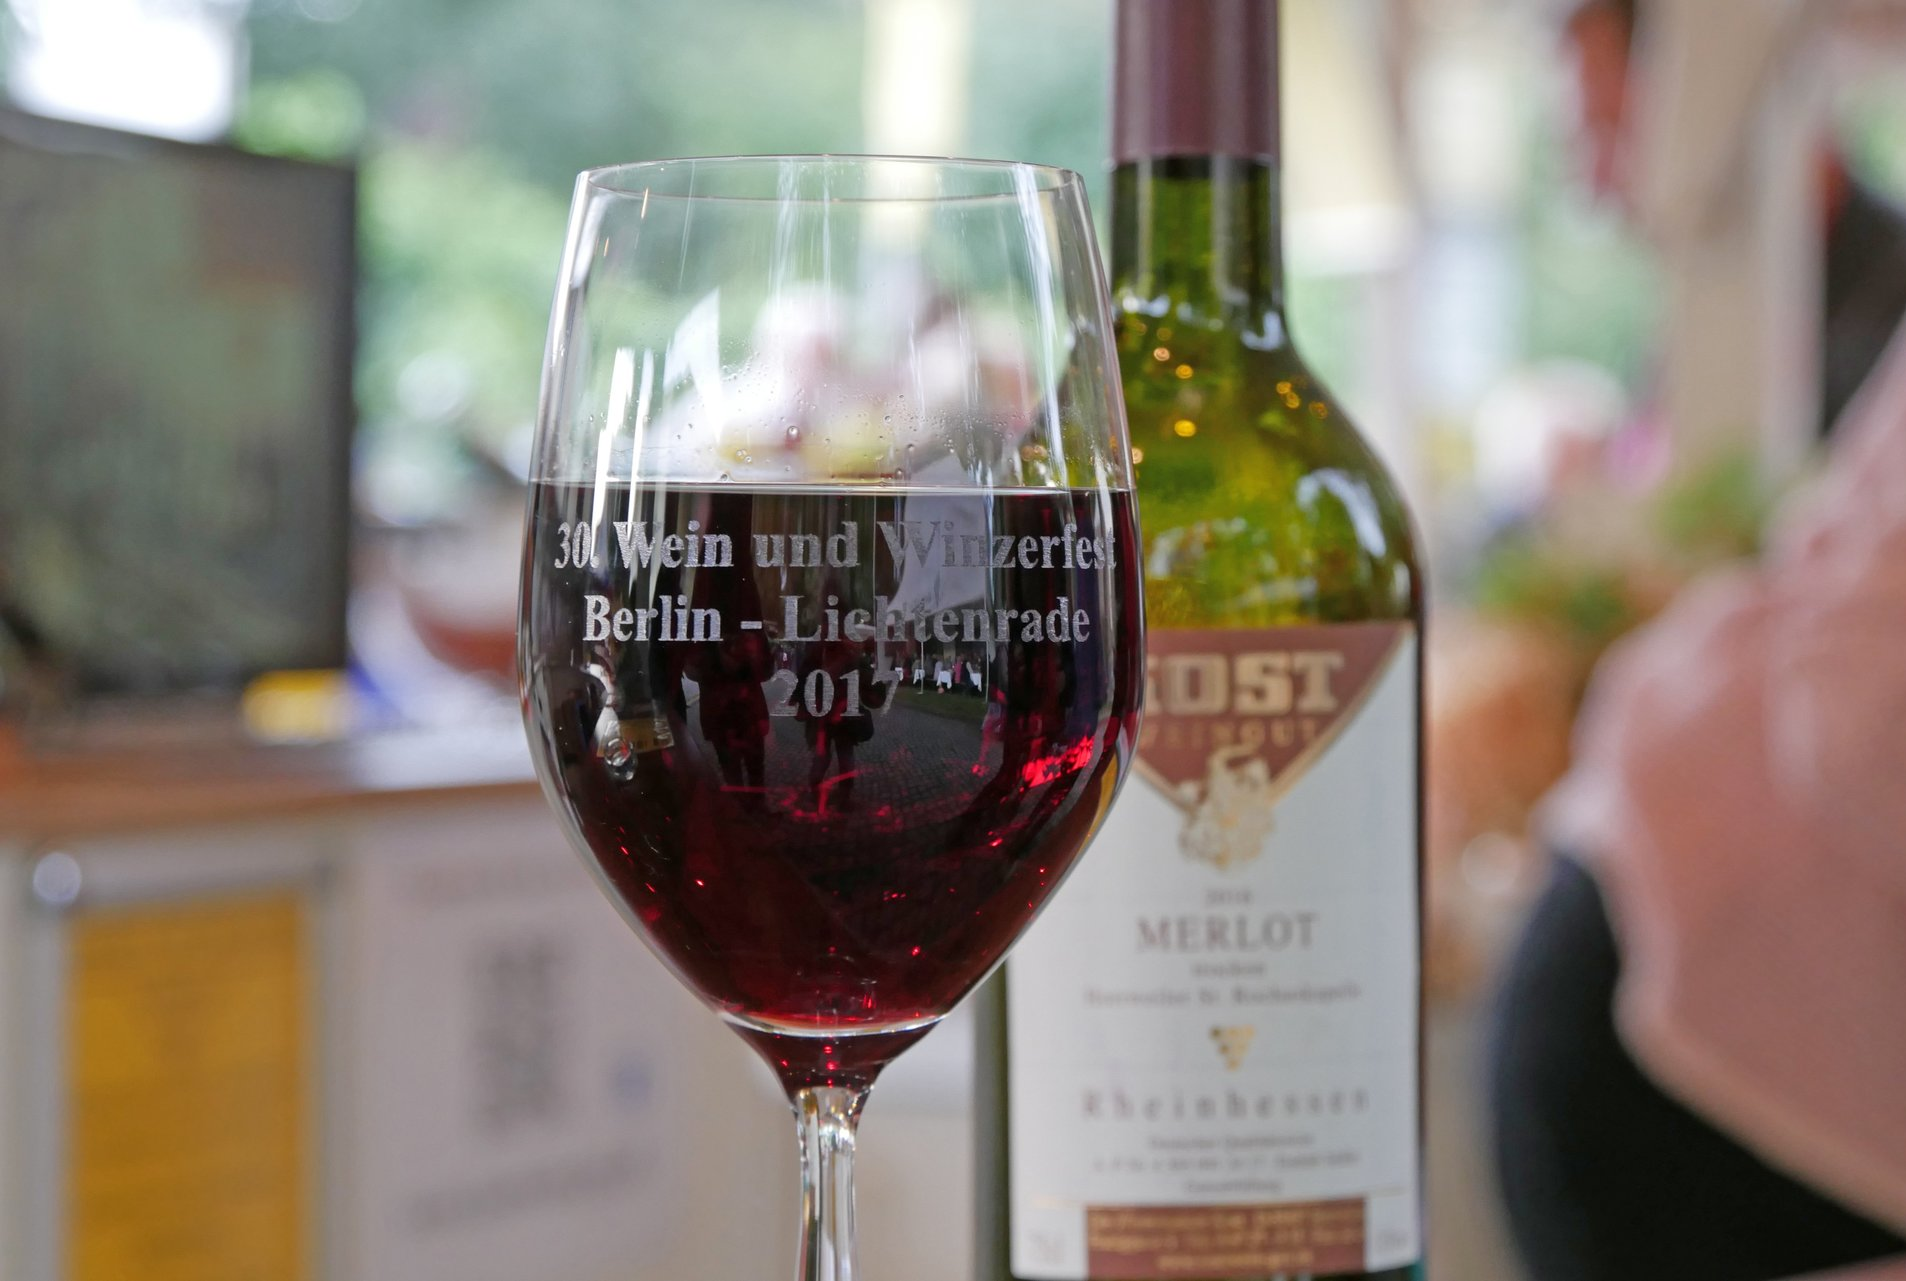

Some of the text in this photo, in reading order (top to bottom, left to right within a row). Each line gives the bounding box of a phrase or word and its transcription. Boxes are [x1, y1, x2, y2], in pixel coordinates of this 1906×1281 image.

[553, 519, 1117, 569] 30. Wein und Winzerfest
[582, 594, 724, 643] Berlin
[780, 595, 1091, 643] Lichtenrade
[768, 668, 900, 717] 2017
[1144, 651, 1345, 715] OST
[1135, 910, 1321, 954] MERLOT
